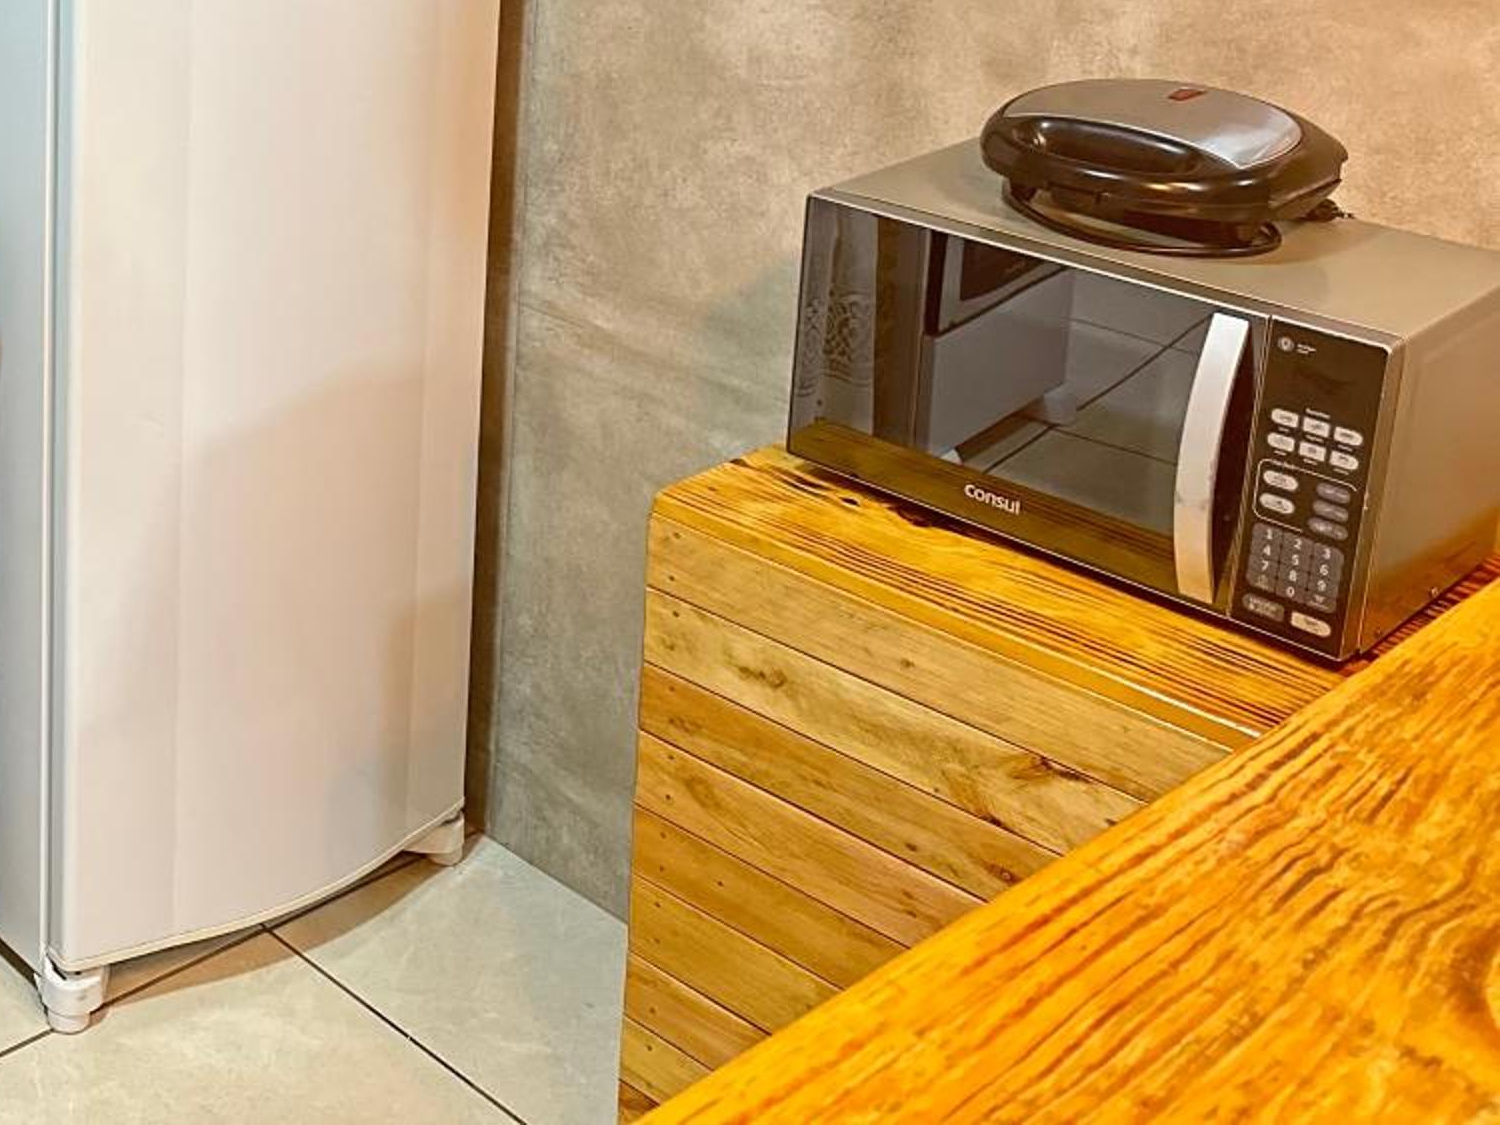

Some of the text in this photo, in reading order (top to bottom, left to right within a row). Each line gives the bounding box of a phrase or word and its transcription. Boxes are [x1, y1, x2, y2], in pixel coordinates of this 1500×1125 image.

[1294, 538, 1302, 550] 2
[1263, 545, 1271, 556] 4
[1322, 548, 1331, 560] 3
[1261, 560, 1269, 571] 7
[1291, 554, 1299, 566] 5
[1320, 564, 1329, 576] 6
[1286, 586, 1295, 598] 0
